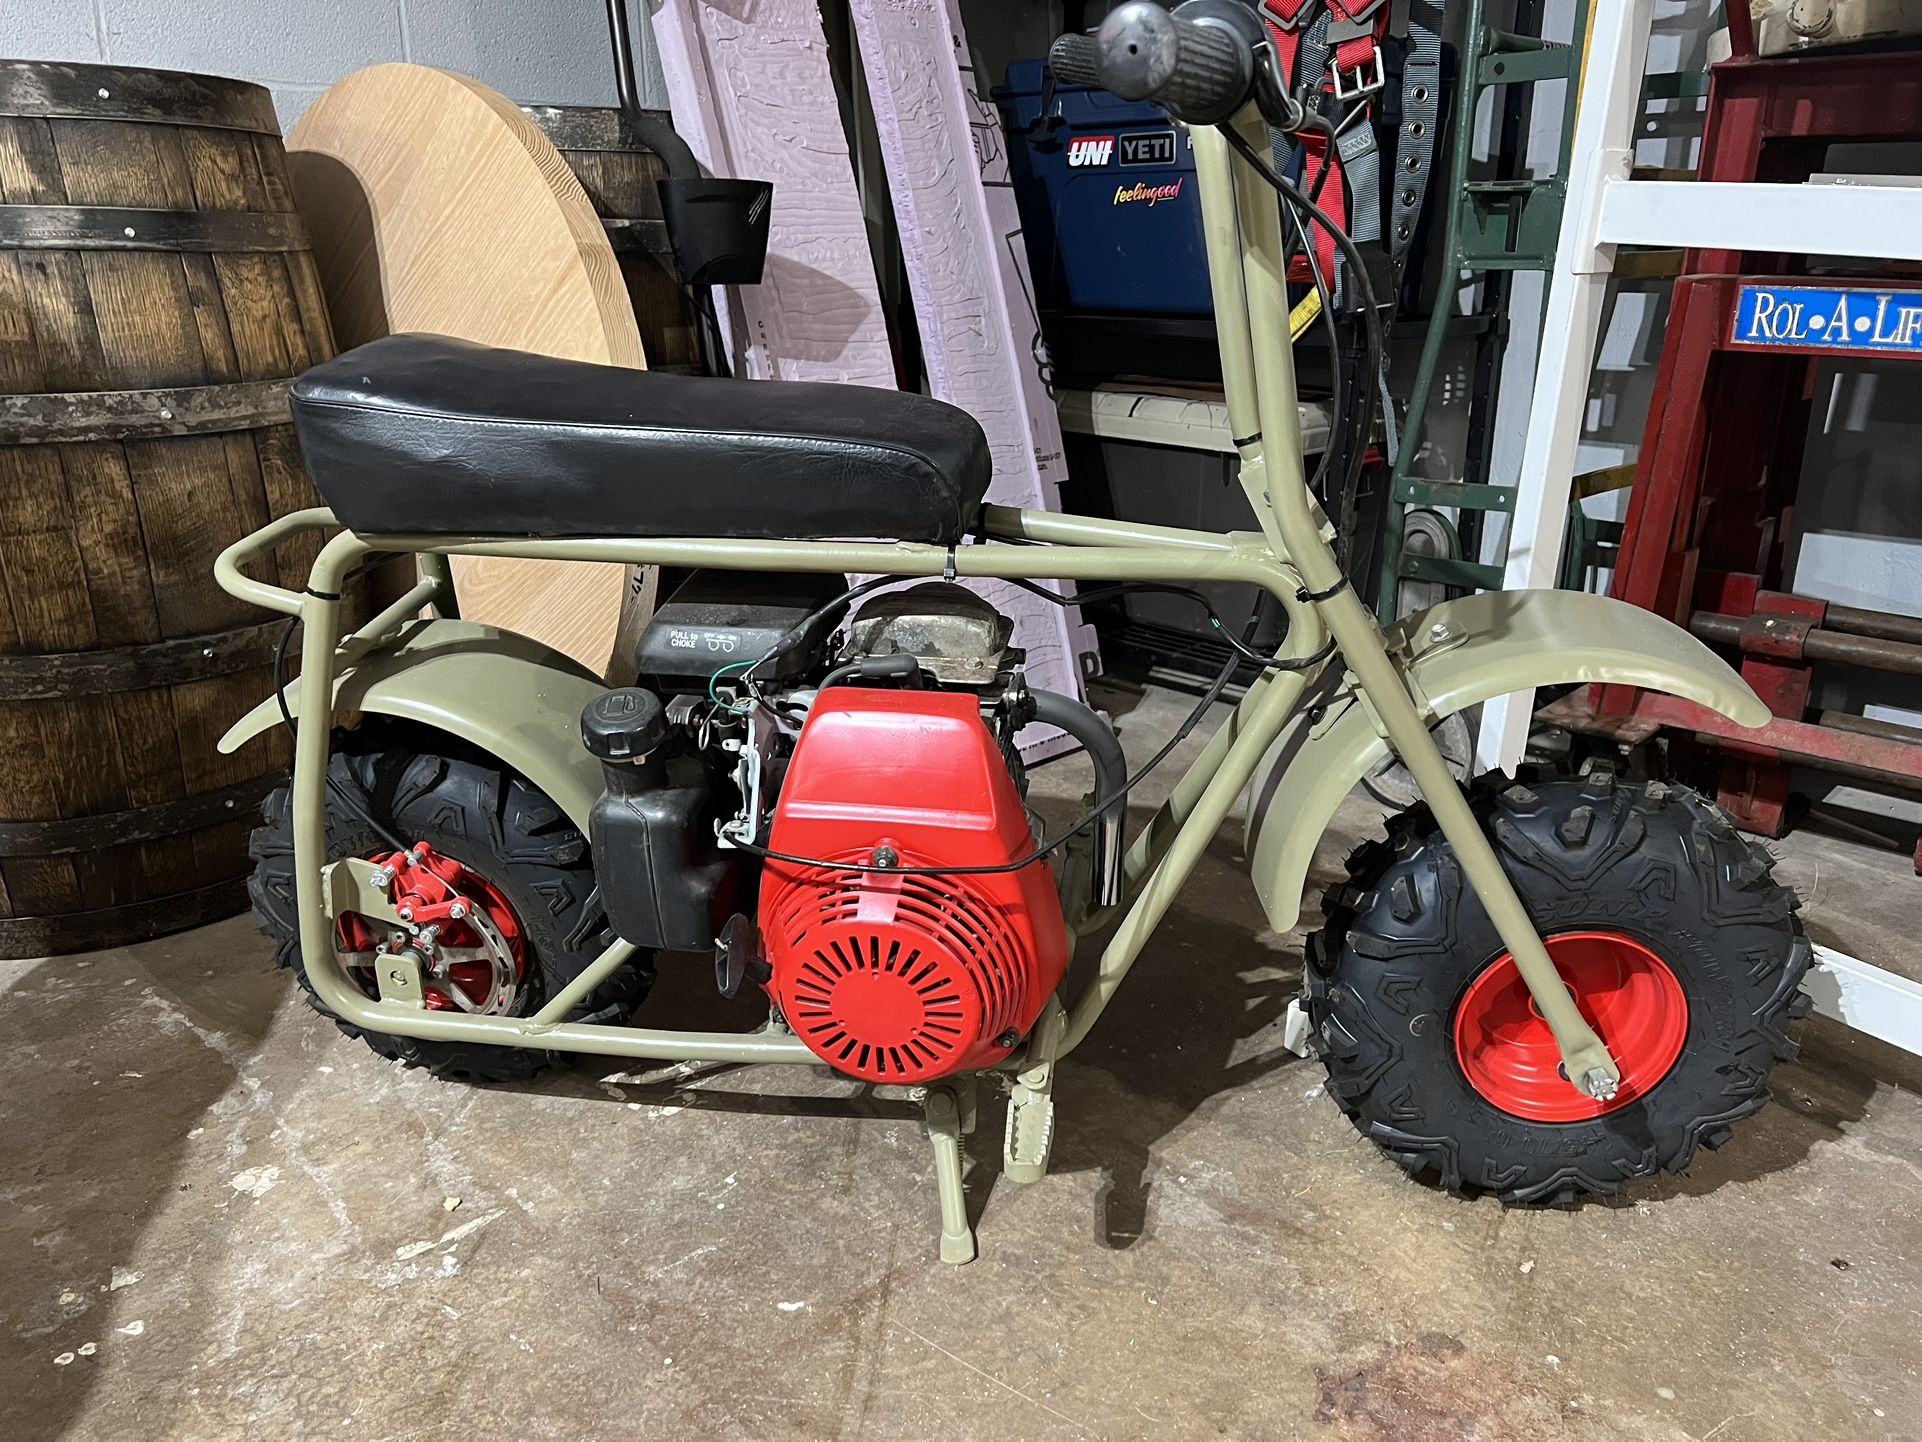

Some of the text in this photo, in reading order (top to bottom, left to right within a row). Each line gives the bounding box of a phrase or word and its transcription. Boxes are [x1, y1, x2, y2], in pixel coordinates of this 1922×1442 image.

[1123, 138, 1170, 160] YETI
[1113, 177, 1184, 207] feelingood
[670, 630, 689, 639] PULL
[671, 639, 696, 649] CHOKE
